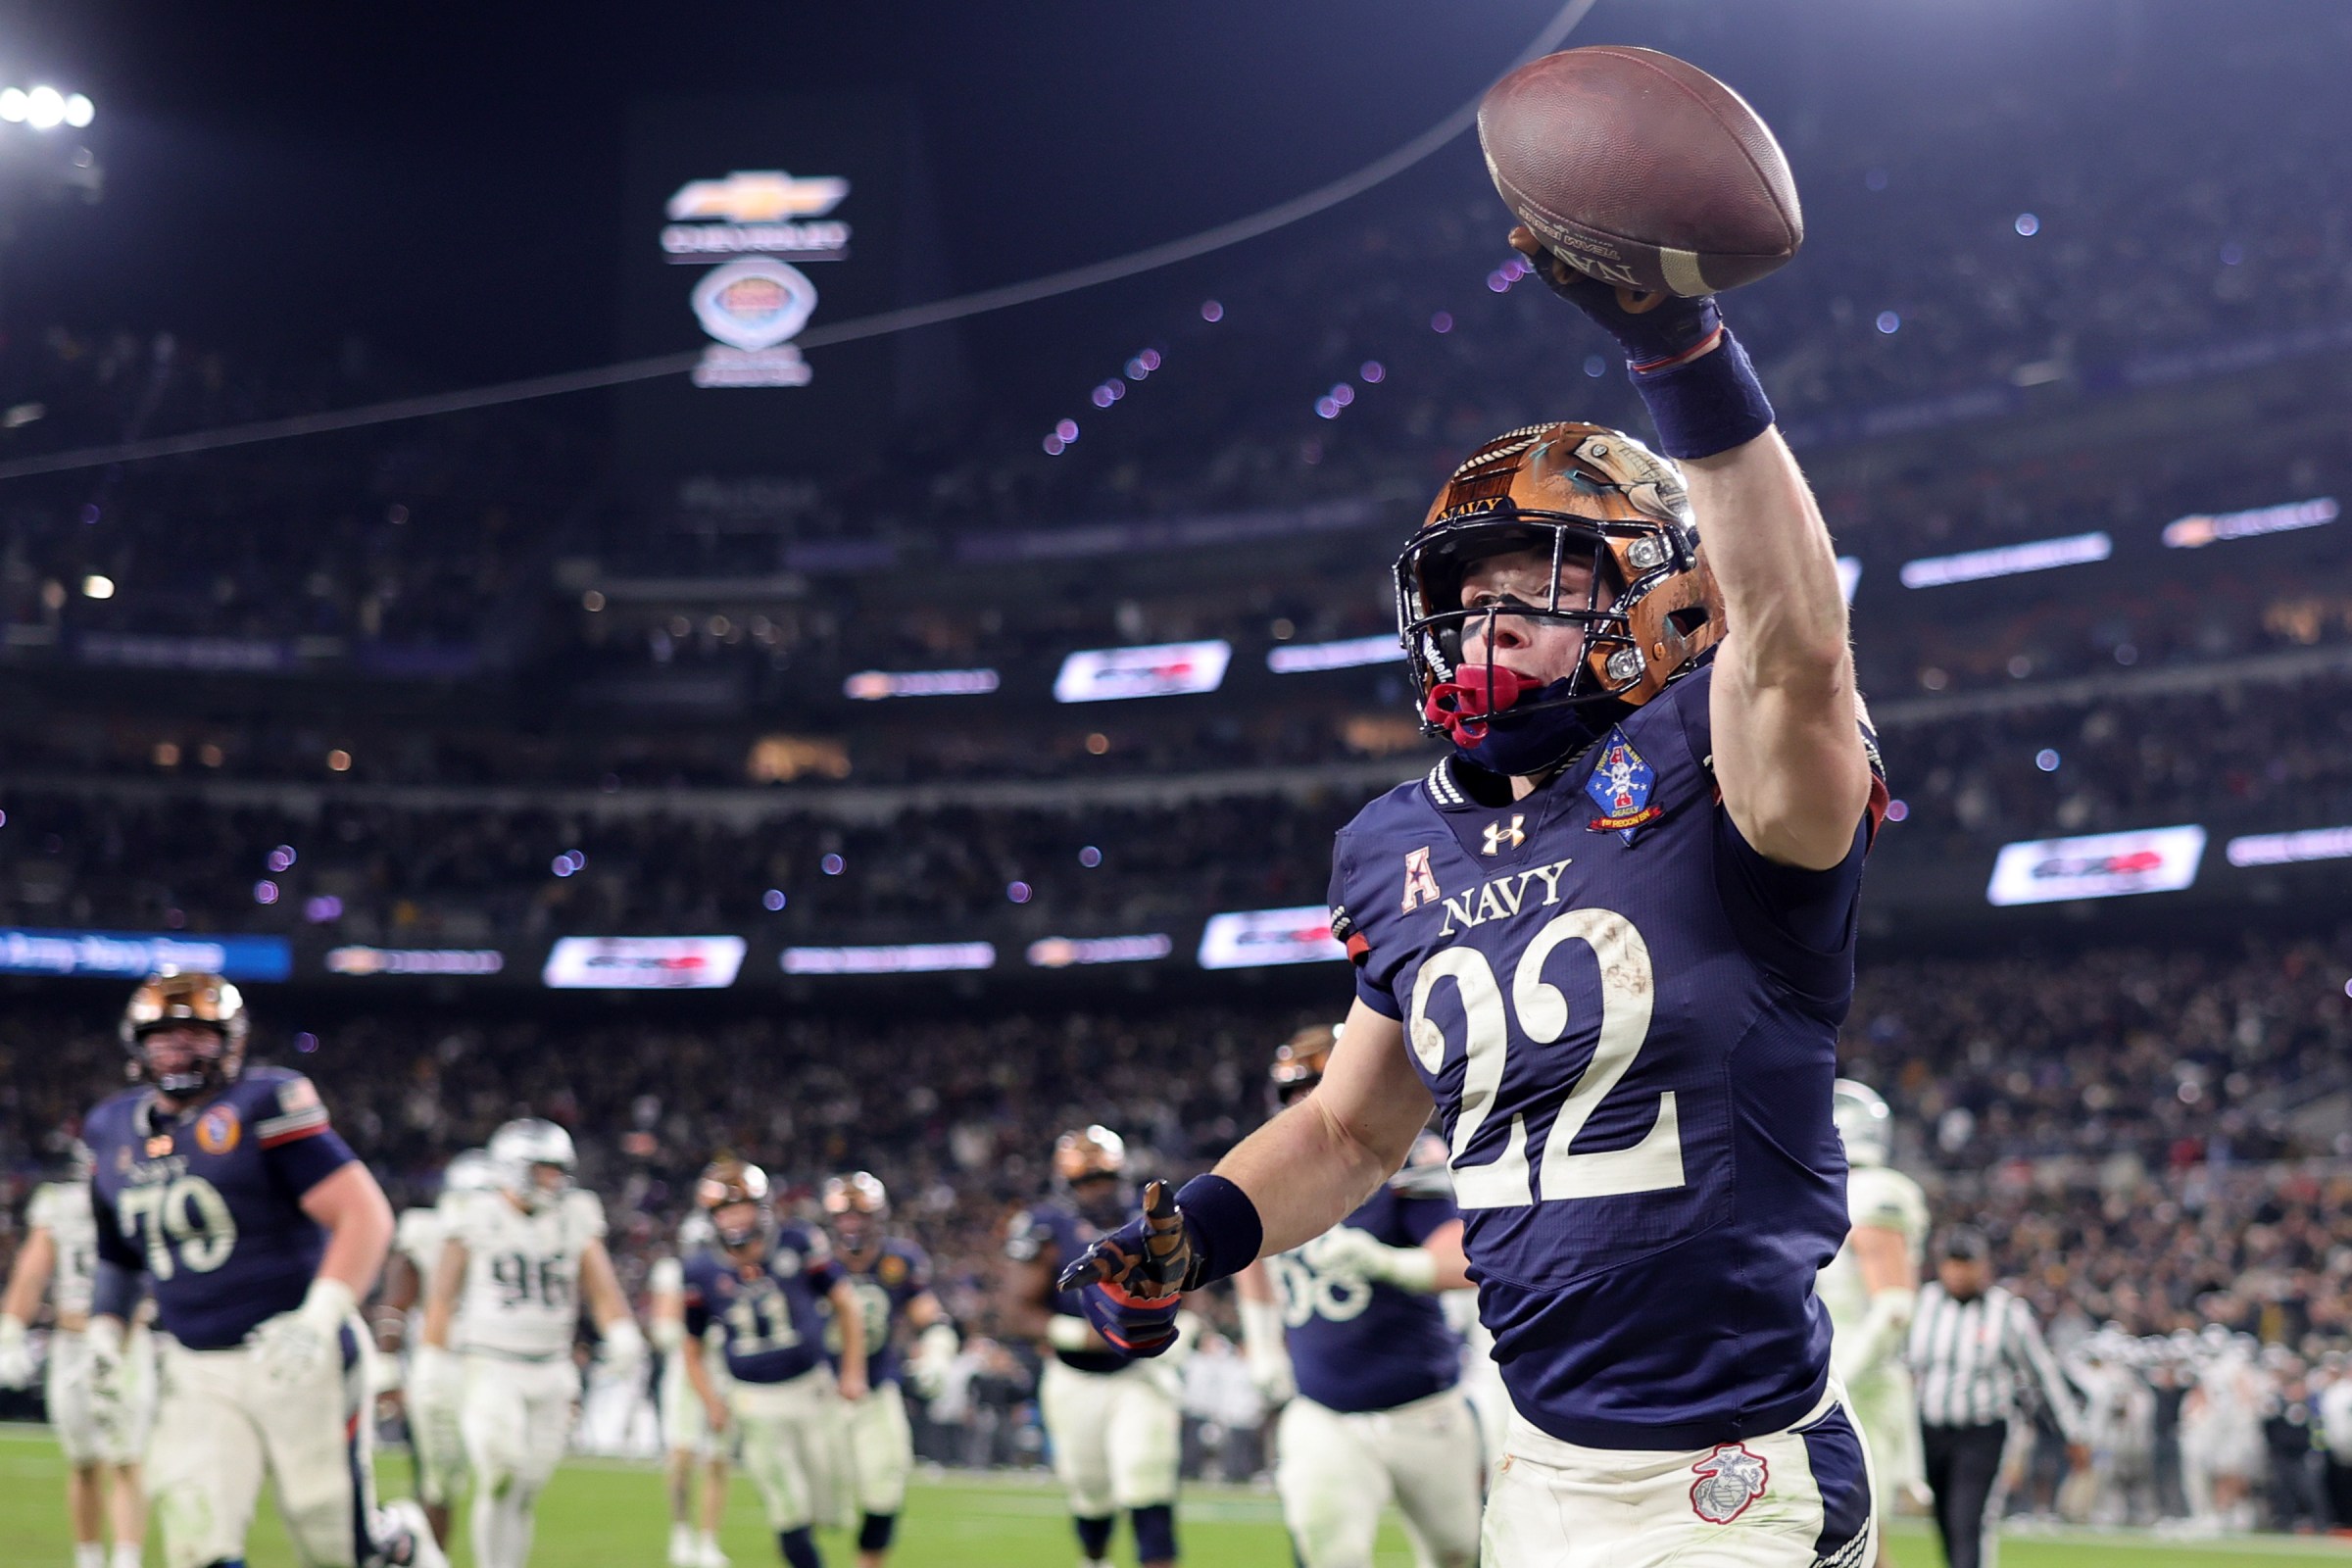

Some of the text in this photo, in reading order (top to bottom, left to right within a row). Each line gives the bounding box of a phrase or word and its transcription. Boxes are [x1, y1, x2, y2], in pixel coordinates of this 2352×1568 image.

[1613, 816, 1639, 827] RECON
[1438, 858, 1573, 937] NAVY
[1408, 906, 1687, 1210] 22
[117, 1174, 238, 1282] 79
[490, 1249, 573, 1310] 96
[723, 1289, 803, 1357] 11
